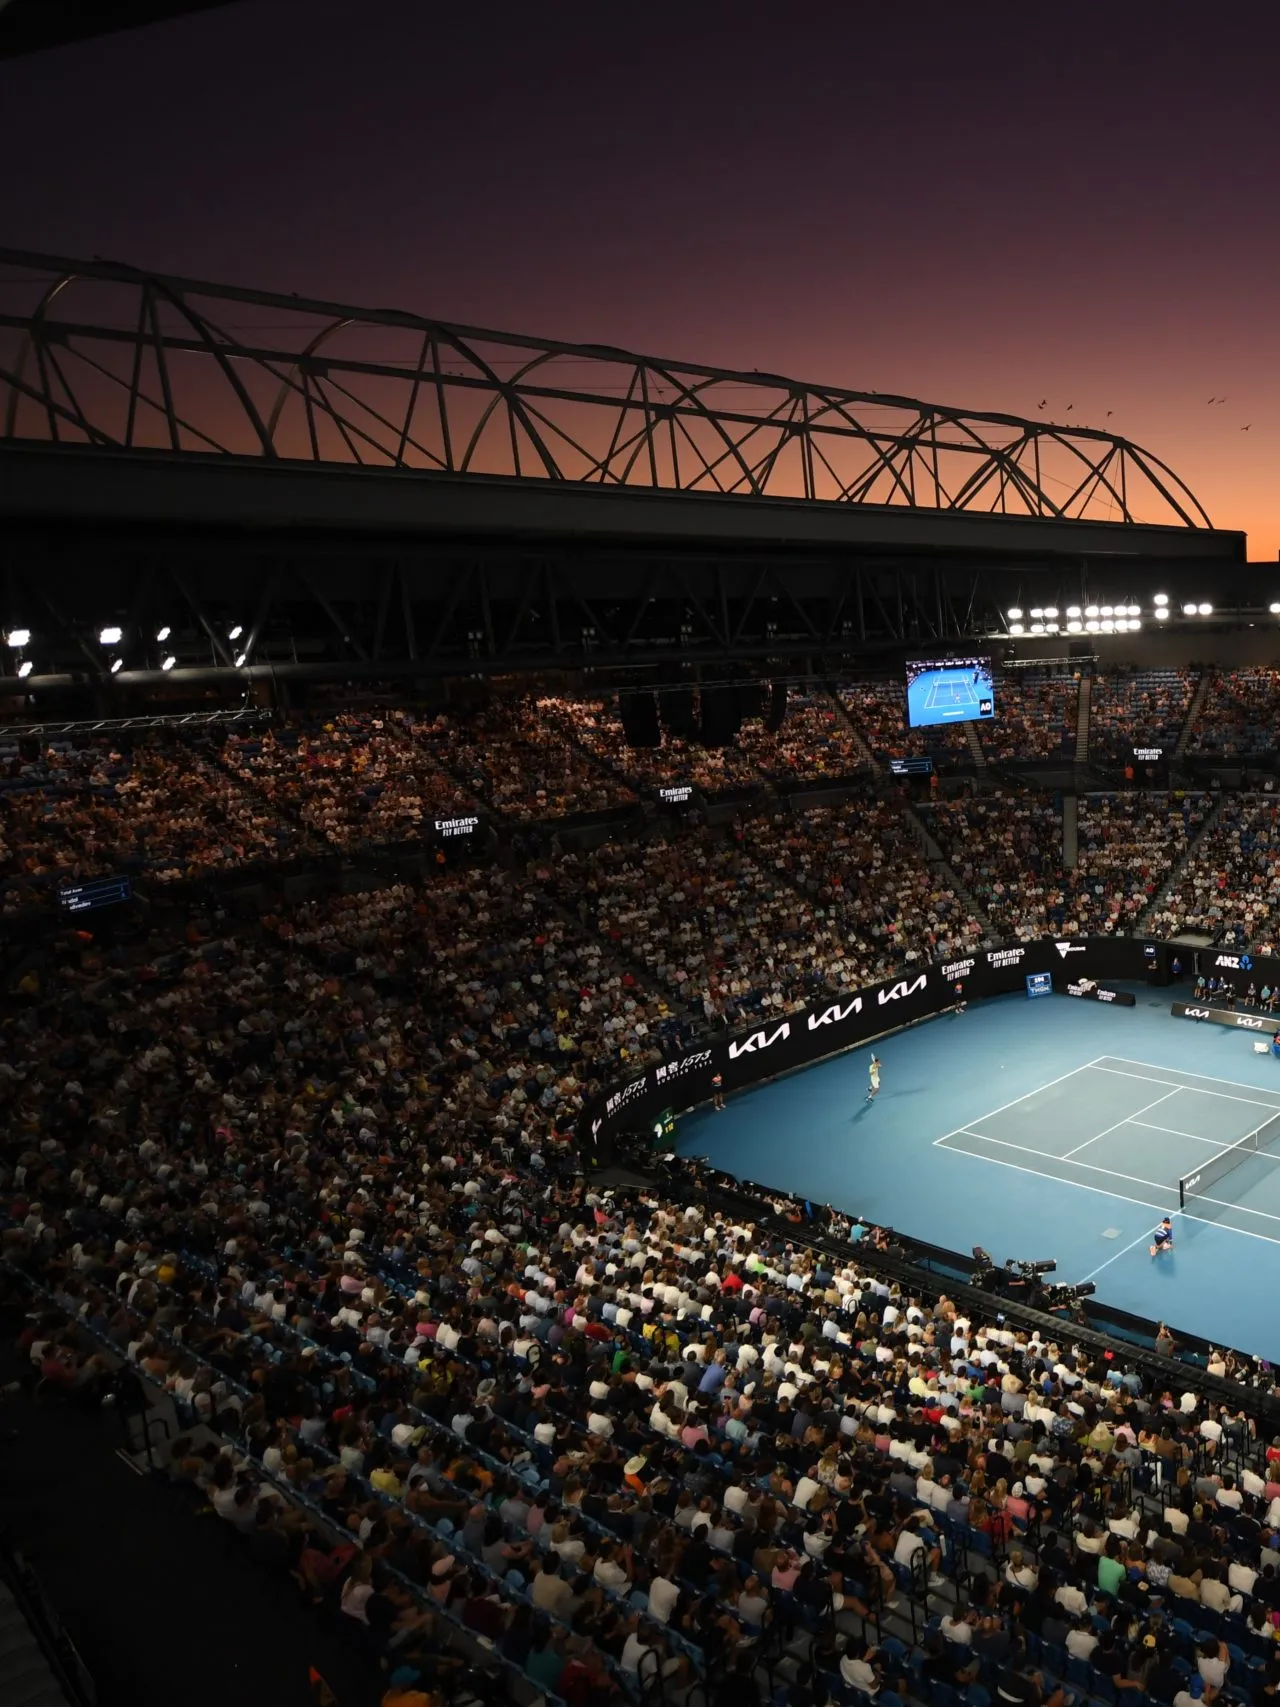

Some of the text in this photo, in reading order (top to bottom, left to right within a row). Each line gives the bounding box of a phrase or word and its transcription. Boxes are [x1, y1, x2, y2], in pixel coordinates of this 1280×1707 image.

[980, 702, 992, 712] AO
[660, 787, 692, 797] Emirates
[435, 816, 478, 830] Emirates
[987, 948, 1025, 962] Emirates
[993, 956, 1020, 968] FLY BETTER
[1215, 955, 1240, 969] ANZ
[942, 958, 975, 975] Emirates
[955, 967, 970, 979] BETTER
[878, 974, 927, 1005] KIA
[808, 997, 862, 1030] KIA
[1185, 1007, 1209, 1018] KIA
[1237, 1017, 1262, 1028] KIA
[729, 1023, 790, 1059] KIA
[680, 1049, 712, 1069] 1573
[622, 1077, 646, 1100] 1573
